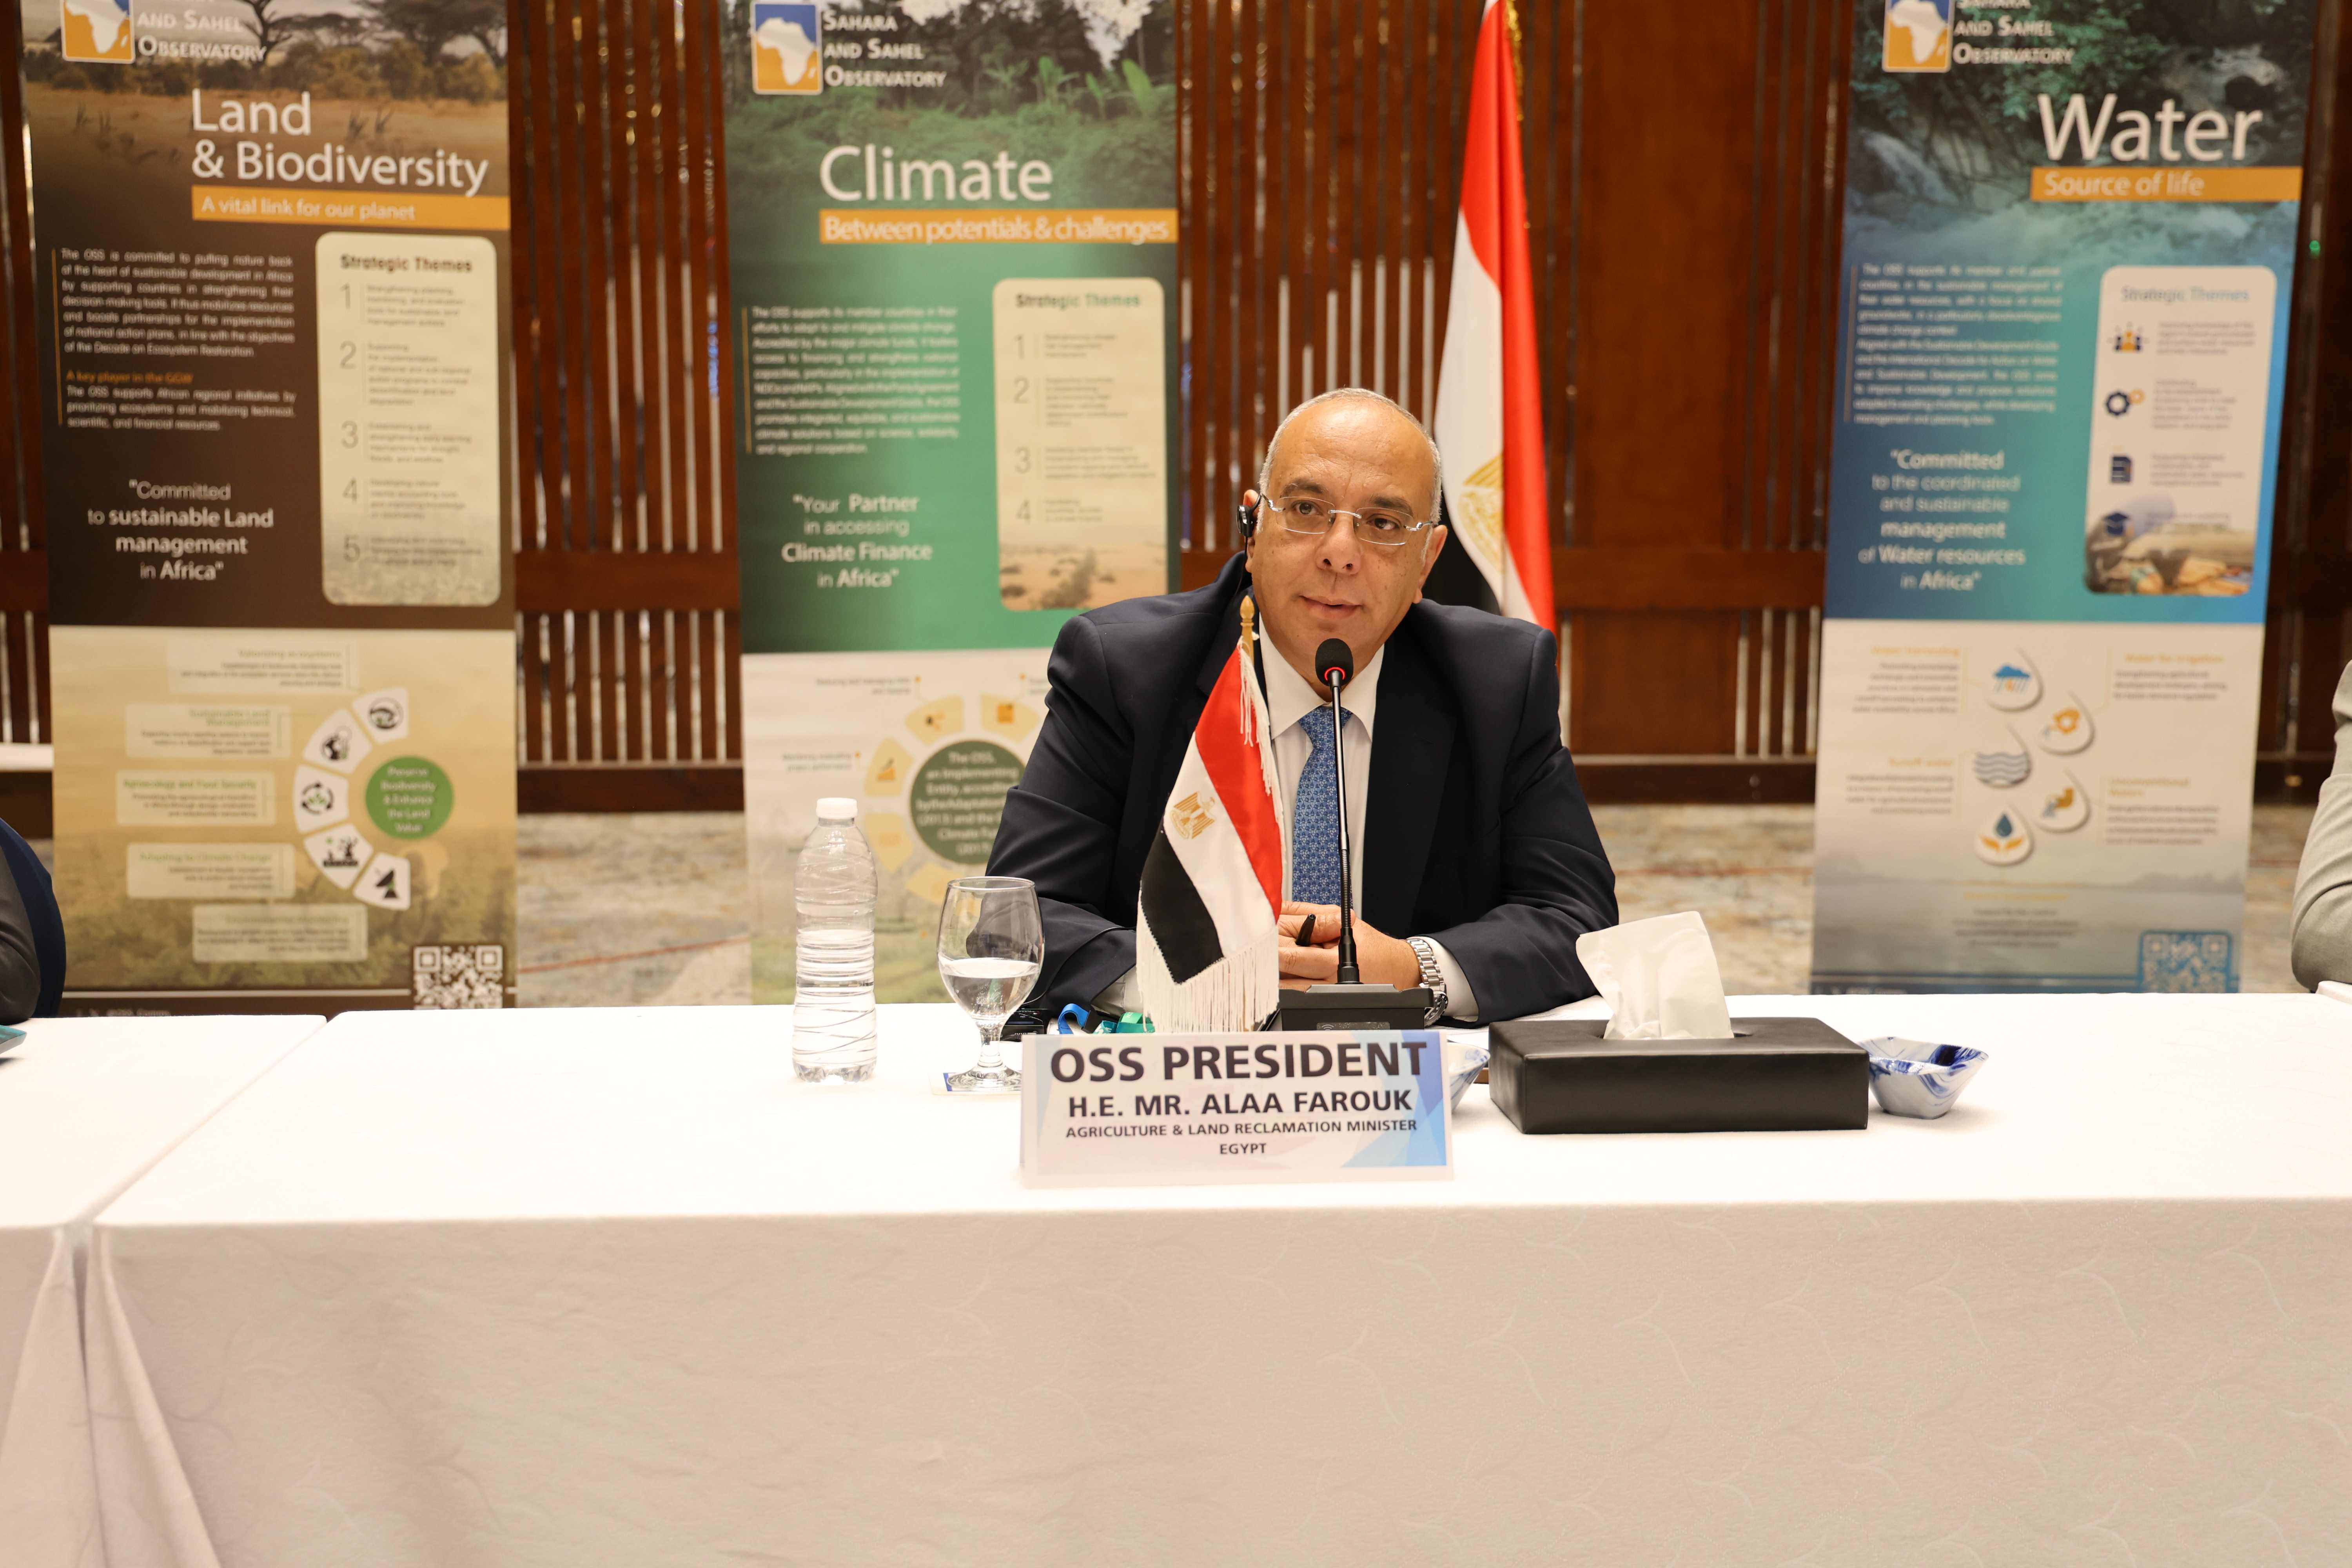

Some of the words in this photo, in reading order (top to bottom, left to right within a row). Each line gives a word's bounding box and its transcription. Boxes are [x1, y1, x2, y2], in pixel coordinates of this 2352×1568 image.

[137, 12, 176, 29] AND
[184, 9, 244, 33] SAHEL
[823, 10, 898, 31] SAHARA
[1953, 20, 1993, 36] AND
[1998, 15, 2054, 36] SAHEL
[138, 35, 267, 62] OBSERVATORY
[824, 43, 862, 59] AND
[867, 38, 925, 59] SAHEL
[1953, 42, 2075, 64] OBSERVATORY
[824, 65, 947, 87] OBSERVATORY
[192, 88, 311, 136] Land
[2037, 94, 2263, 162] Water
[192, 139, 225, 178] &
[236, 141, 489, 197] Biodiversity
[820, 144, 1053, 201] Climate
[2043, 171, 2131, 196] Source
[2135, 171, 2166, 196] of
[2167, 170, 2205, 196] life
[201, 196, 215, 213] A
[218, 198, 256, 214] vital
[261, 198, 292, 216] link
[297, 198, 319, 216] for
[325, 203, 355, 218] our
[359, 202, 415, 221] planet
[824, 216, 922, 240] Between
[926, 216, 1032, 245] potentials
[1035, 218, 1056, 240] &
[1054, 217, 1169, 245] challenges
[340, 254, 409, 273] Strategic
[415, 256, 472, 272] Themes
[340, 283, 350, 310] 1
[1016, 293, 1080, 310] Strategic
[1085, 292, 1140, 307] Themes
[2121, 285, 2186, 305] Strategic
[2190, 286, 2250, 302] Themes
[340, 341, 356, 369] 2
[1013, 376, 1030, 404] 2
[341, 420, 358, 448] 3
[1014, 446, 1032, 474] 3
[1890, 448, 2005, 470] "Committed
[129, 479, 231, 501] "Committed
[343, 478, 359, 503] 4
[1872, 474, 1890, 491] to
[1892, 473, 1919, 491] the
[1921, 474, 2021, 492] coordinated
[792, 494, 840, 514] "Your
[848, 493, 920, 513] Partner
[1016, 500, 1031, 524] 4
[1880, 495, 1915, 512] and
[1915, 496, 2009, 513] sustainable
[88, 508, 105, 525] to
[109, 506, 220, 527] sustainable
[224, 508, 274, 528] Land
[804, 518, 820, 535] in
[823, 517, 910, 537] accessing
[1881, 521, 2007, 543] management
[116, 536, 248, 557] management
[343, 535, 361, 563] 5
[781, 542, 856, 563] Climate
[858, 541, 933, 561] Finance
[1858, 545, 1876, 564] of
[1878, 544, 1934, 564] Water
[1936, 548, 2026, 565] resources
[140, 561, 156, 579] in
[160, 559, 224, 580] Africa"
[817, 571, 833, 587] in
[836, 567, 899, 588] Africa"
[1900, 572, 1917, 589] in
[1919, 569, 1982, 591] Africa"
[380, 780, 437, 793] Biodiversity
[394, 822, 423, 833] Value
[1051, 1047, 1144, 1082] OSS
[1163, 1042, 1427, 1080] PRESIDENT
[1069, 1096, 1123, 1117] H.E.
[1135, 1094, 1190, 1116] MR.
[1201, 1093, 1283, 1114] ALAA
[1294, 1089, 1412, 1112] FAROUK
[1066, 1125, 1166, 1137] AGRICULTURE
[1173, 1125, 1183, 1135] &
[1189, 1124, 1229, 1135] LAND
[1235, 1121, 1341, 1134] RECLAMATION
[1347, 1120, 1417, 1132] MINISTER
[1220, 1143, 1266, 1154] EGYPT
